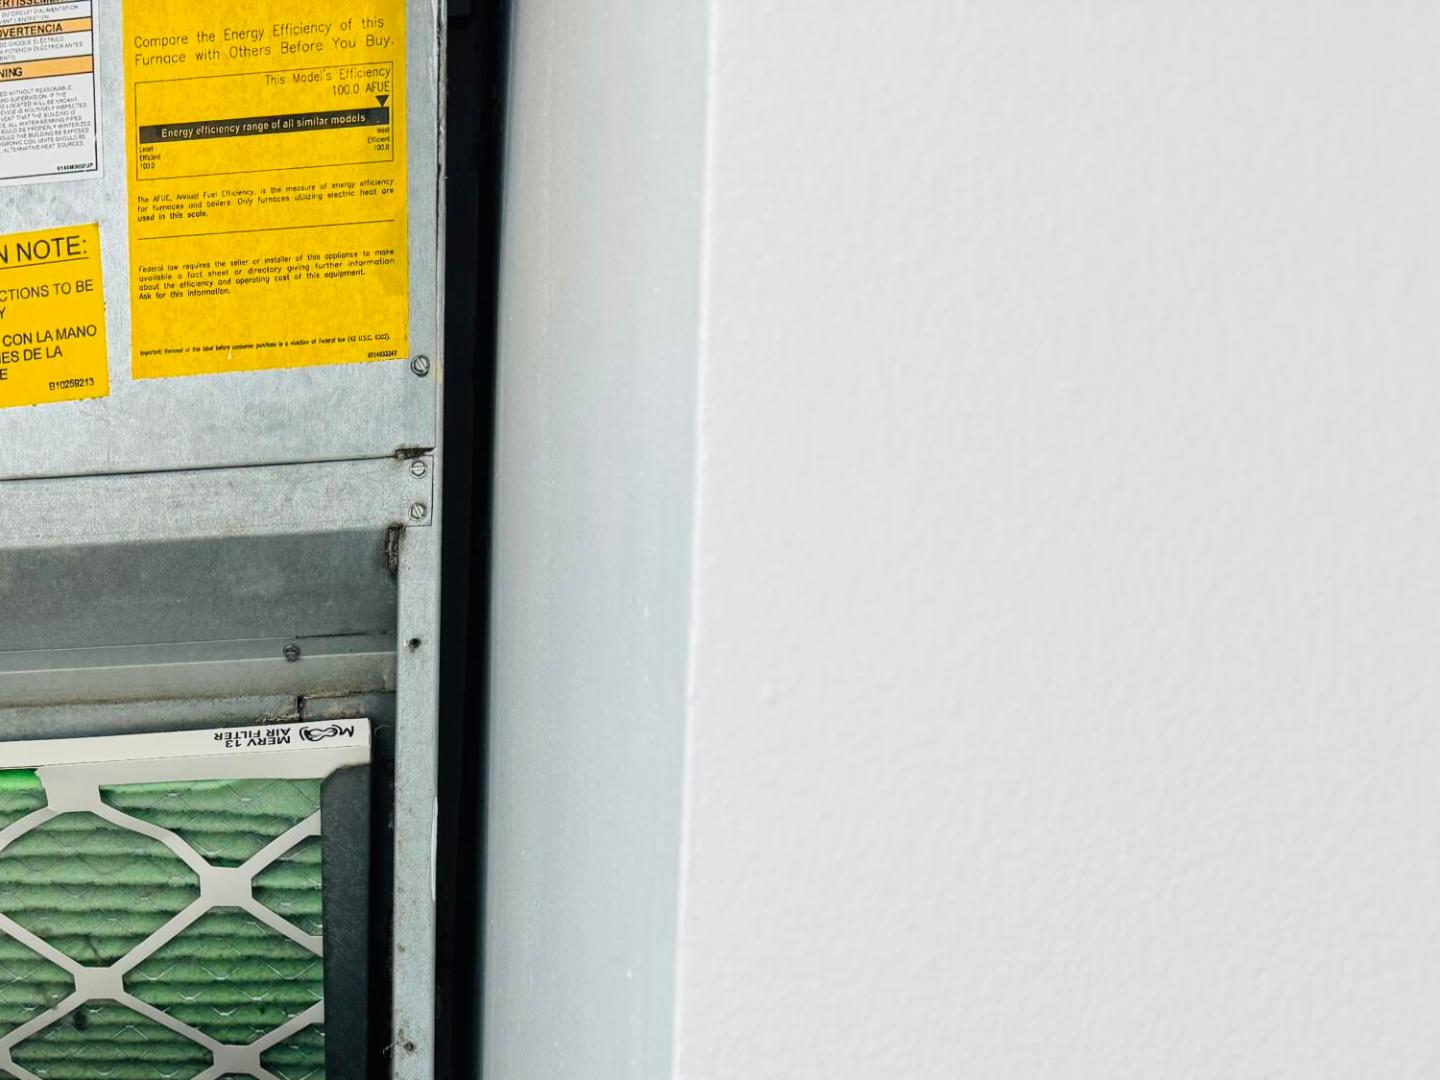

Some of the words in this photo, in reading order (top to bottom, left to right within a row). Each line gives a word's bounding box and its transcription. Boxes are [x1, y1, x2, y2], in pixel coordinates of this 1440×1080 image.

[134, 35, 188, 48] Compare
[196, 31, 215, 44] the
[224, 27, 264, 41] Energy
[272, 22, 332, 37] Efficiency
[340, 18, 352, 31] of
[361, 16, 384, 31] this
[135, 53, 186, 66] Furnace
[195, 48, 220, 61] with
[229, 45, 271, 59] Others
[280, 40, 323, 54] Before
[331, 37, 356, 49] You
[366, 34, 394, 49] Buy.
[264, 74, 285, 86] This
[339, 65, 392, 80] Efficiency
[333, 83, 360, 96] 100.0
[365, 81, 390, 94] AFUE
[161, 128, 193, 138] Energy
[196, 125, 240, 135] efficiency
[243, 122, 269, 132] range
[271, 119, 280, 129] of
[283, 119, 294, 128] all
[296, 116, 328, 127] similar
[331, 113, 365, 127] models
[16, 235, 87, 262] NOTE:
[53, 282, 72, 295] TO
[75, 279, 94, 293] BE
[139, 292, 151, 300] Ask
[187, 287, 230, 296] information.
[2, 332, 32, 347] CON
[36, 330, 53, 343] LA
[56, 324, 97, 341] MANO
[23, 347, 42, 361] DE
[46, 345, 63, 359] LA
[214, 729, 261, 741] FILTER
[266, 727, 291, 737] AIR
[225, 739, 242, 748] 13
[246, 735, 291, 747] MERV
